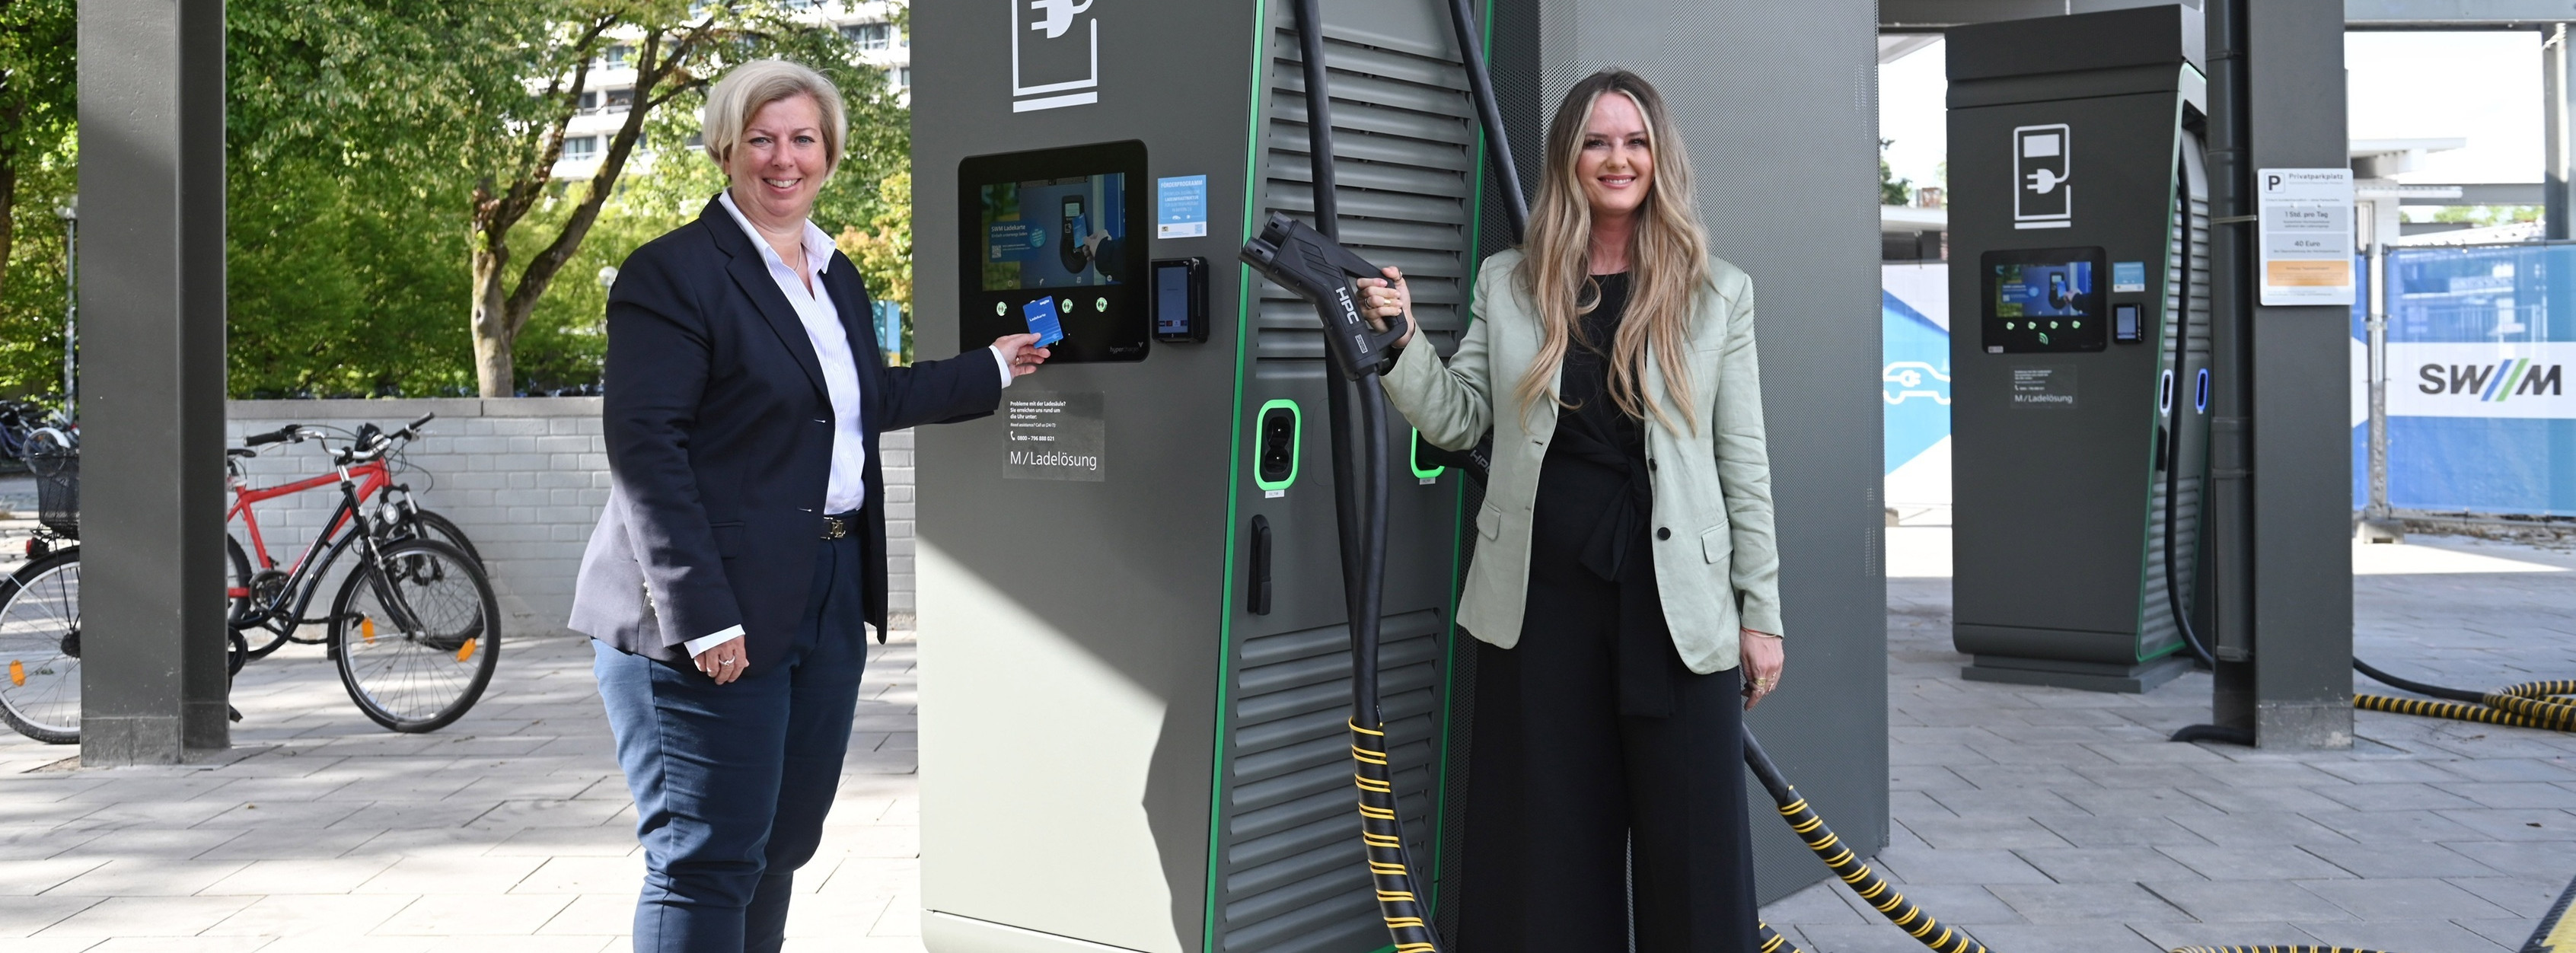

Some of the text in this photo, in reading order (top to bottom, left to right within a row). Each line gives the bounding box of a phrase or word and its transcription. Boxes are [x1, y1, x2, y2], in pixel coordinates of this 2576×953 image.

[1161, 180, 1203, 188] FÖRDERPROGRAMM
[2268, 175, 2281, 191] P
[1335, 286, 1360, 325] HPC
[1029, 313, 1046, 322] Ladekarte
